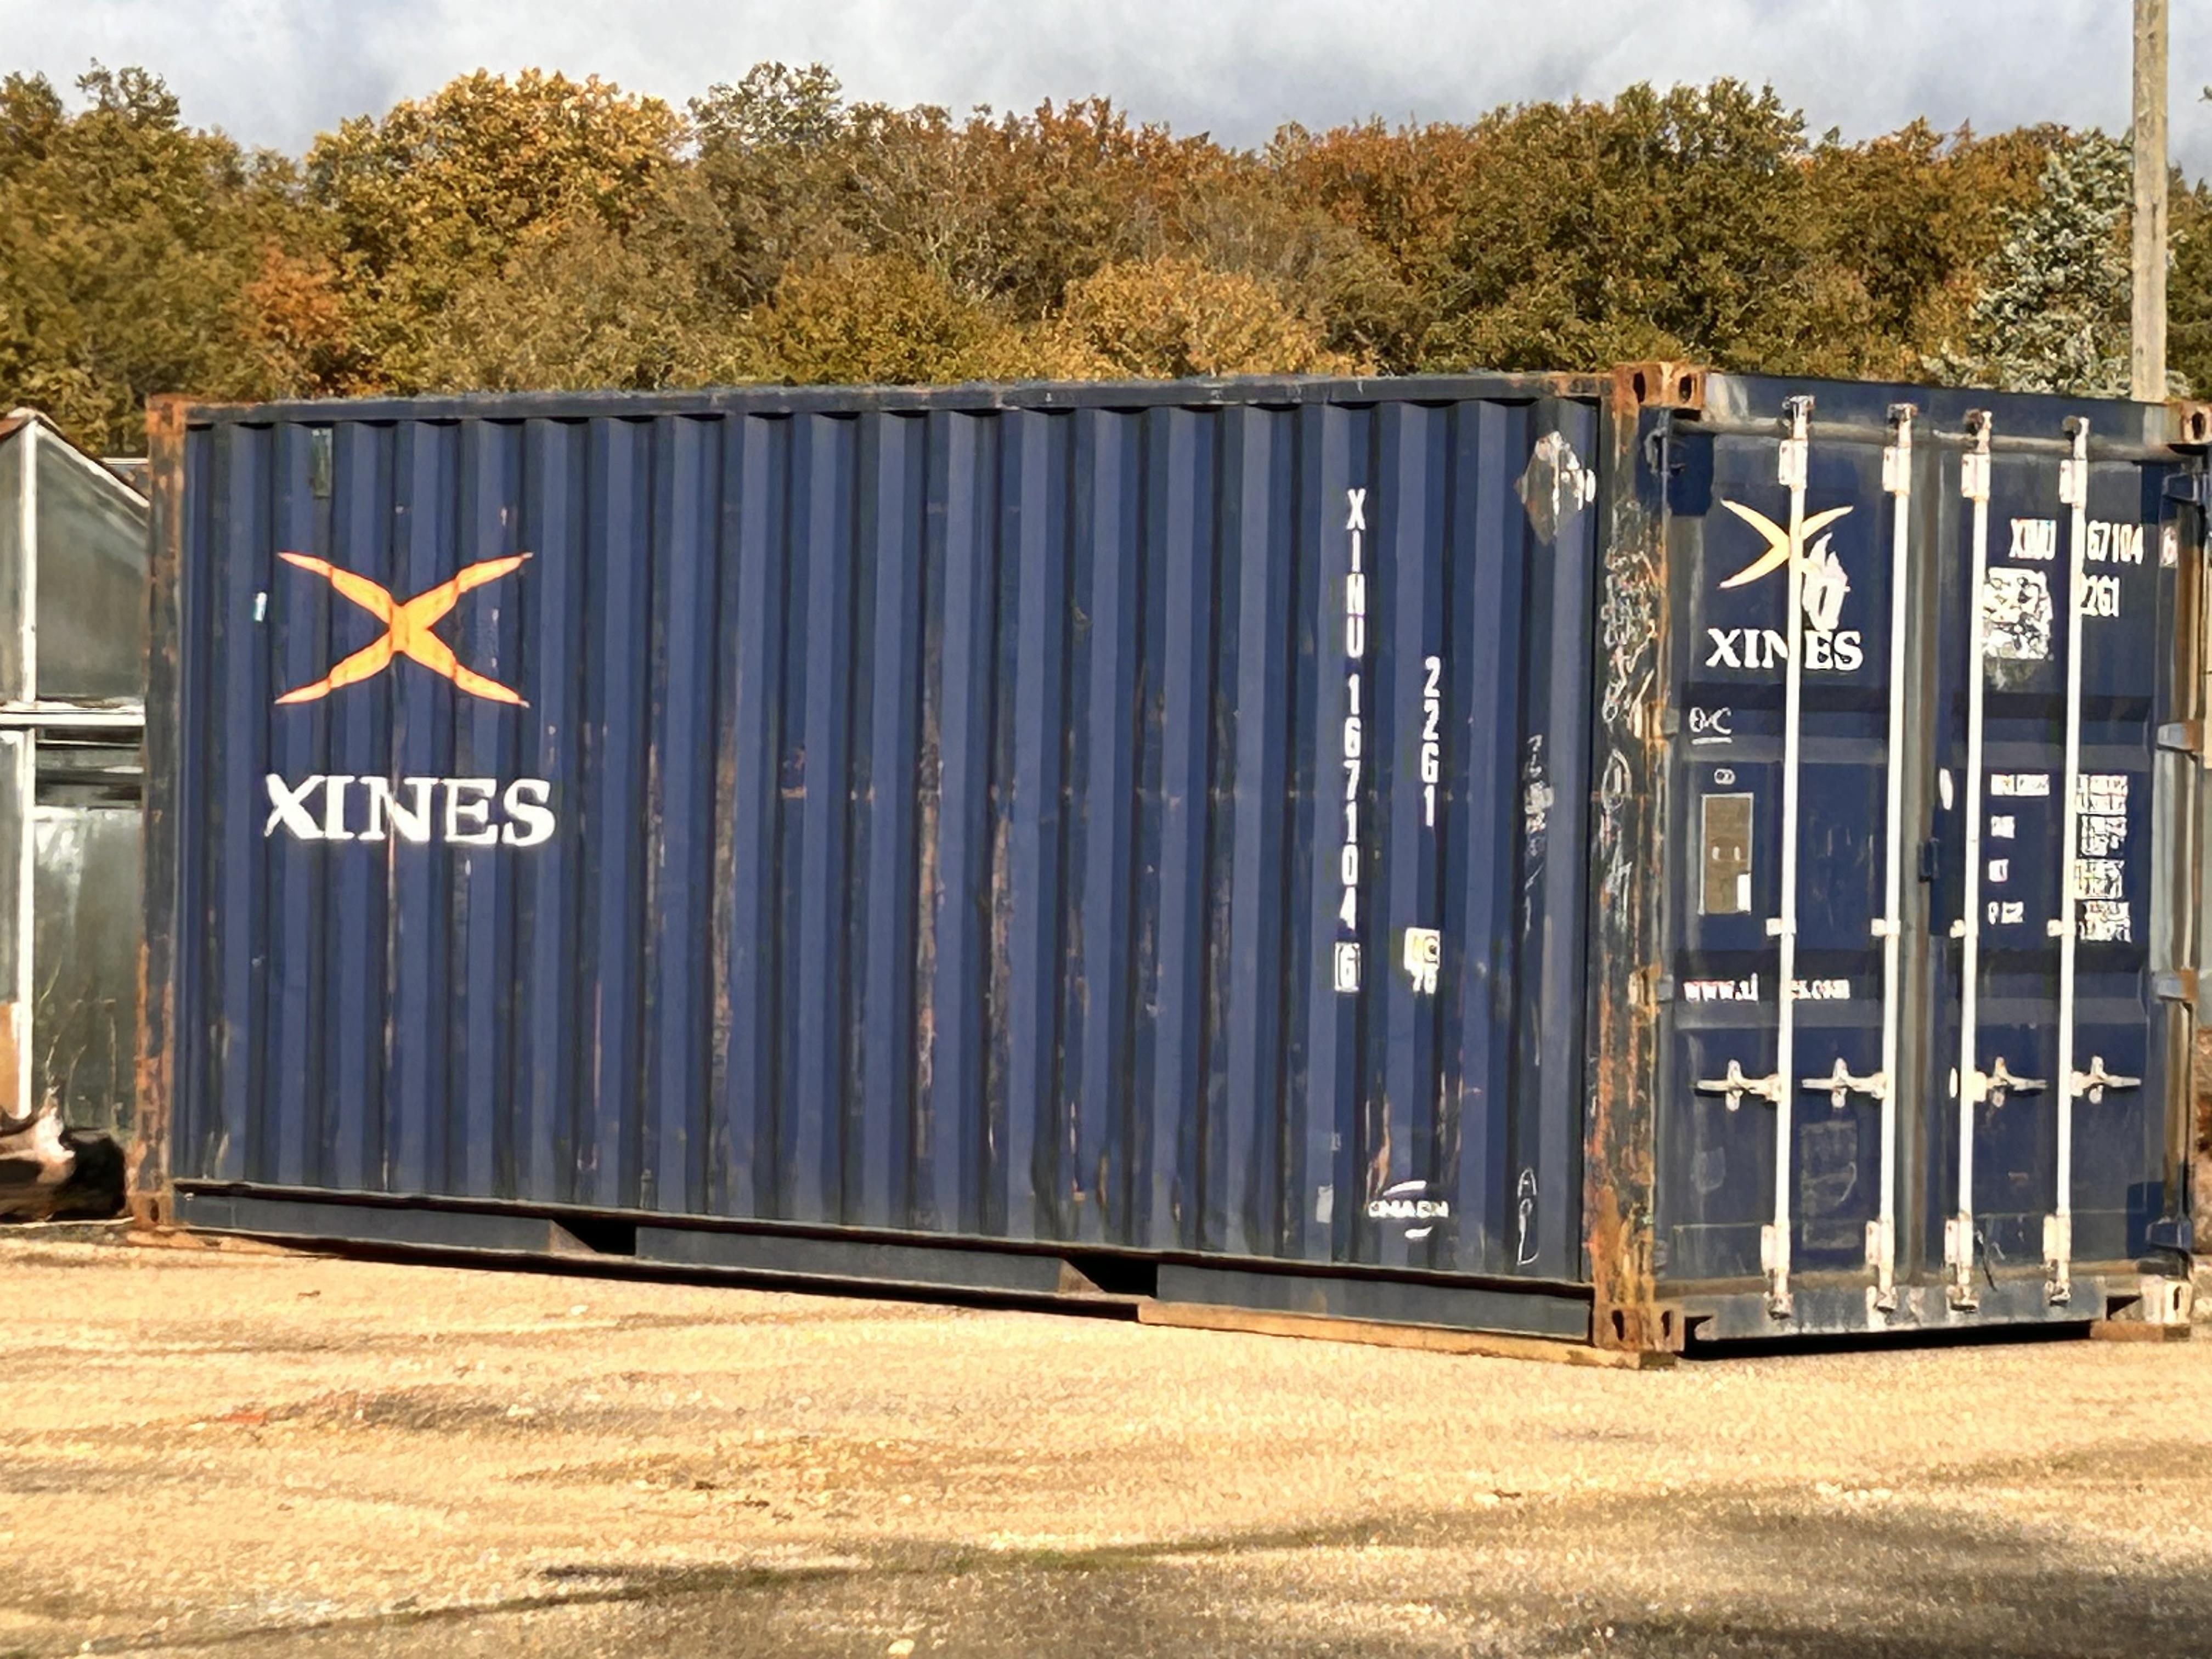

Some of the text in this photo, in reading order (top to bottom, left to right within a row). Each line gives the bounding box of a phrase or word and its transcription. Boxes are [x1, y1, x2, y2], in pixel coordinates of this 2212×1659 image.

[2086, 519, 2144, 565] 67104
[1705, 628, 1864, 670] XINES
[264, 774, 556, 847] XINES
